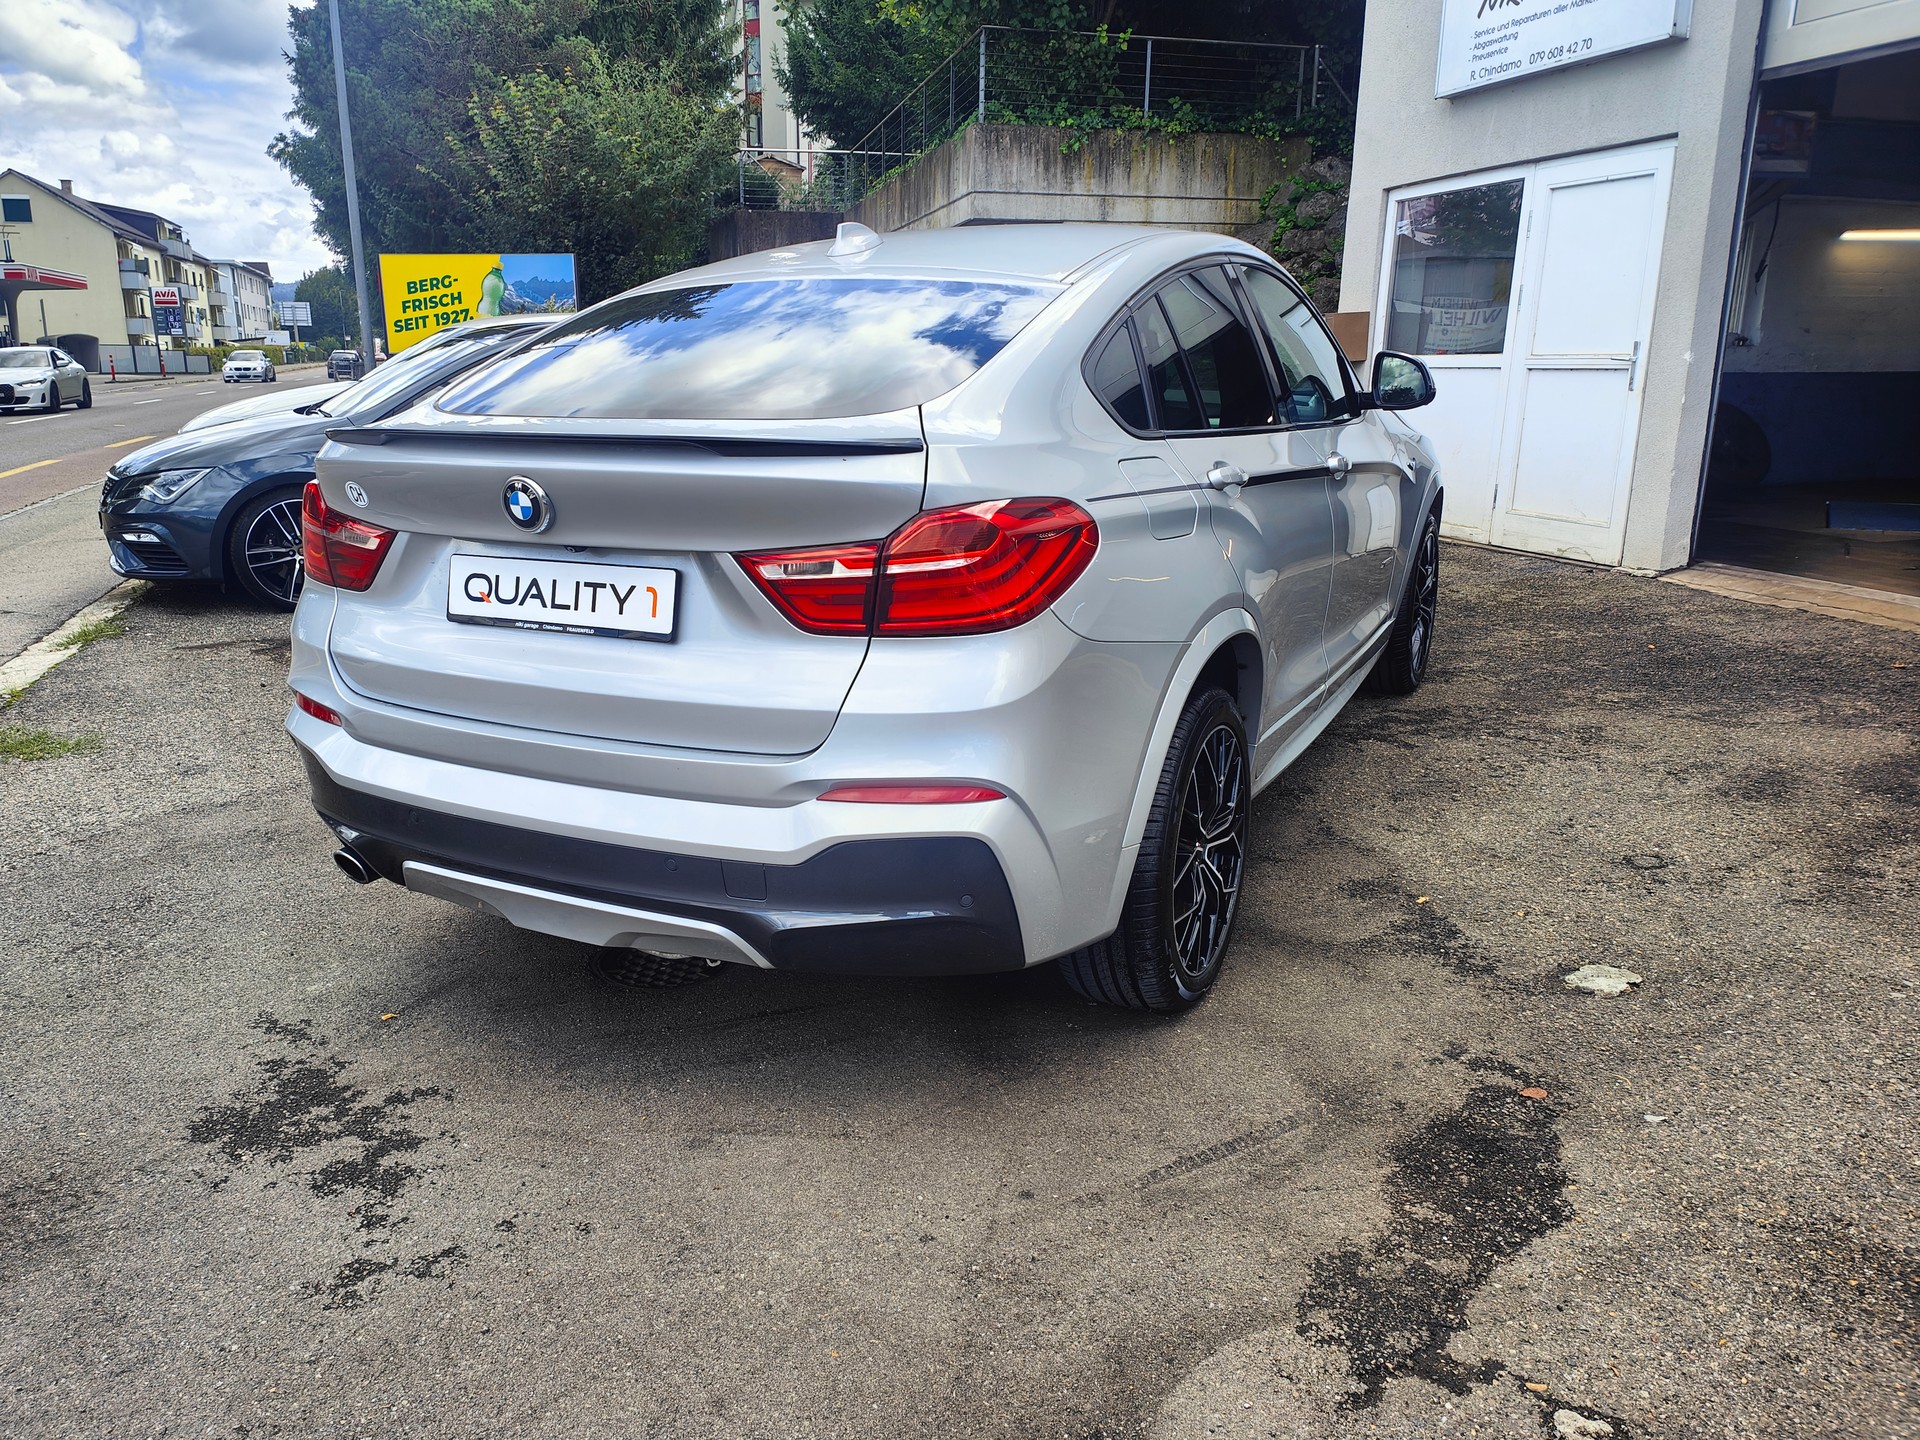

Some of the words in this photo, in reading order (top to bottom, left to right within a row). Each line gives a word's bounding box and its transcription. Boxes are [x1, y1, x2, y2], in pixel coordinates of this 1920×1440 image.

[1474, 27, 1496, 39] Service
[1497, 21, 1510, 32] und
[1511, 9, 1552, 28] Reparaturen
[1553, 4, 1569, 15] aller
[1473, 31, 1519, 51] Abgaswartung
[1472, 46, 1509, 63] Pneuservice
[1479, 59, 1522, 79] Chindamo
[1529, 50, 1546, 65] 079
[1547, 45, 1564, 60] 608
[1566, 41, 1579, 55] 42
[1580, 37, 1593, 51] 70
[406, 274, 459, 295] BERG-
[401, 291, 463, 314] FRISCH
[393, 315, 429, 333] SEIT
[433, 308, 475, 327] 1927.
[349, 485, 366, 503] CH
[506, 482, 536, 499] BMW
[464, 572, 637, 616] QUALITY
[646, 585, 658, 618] 1
[566, 626, 595, 634] FRAUENFELD
